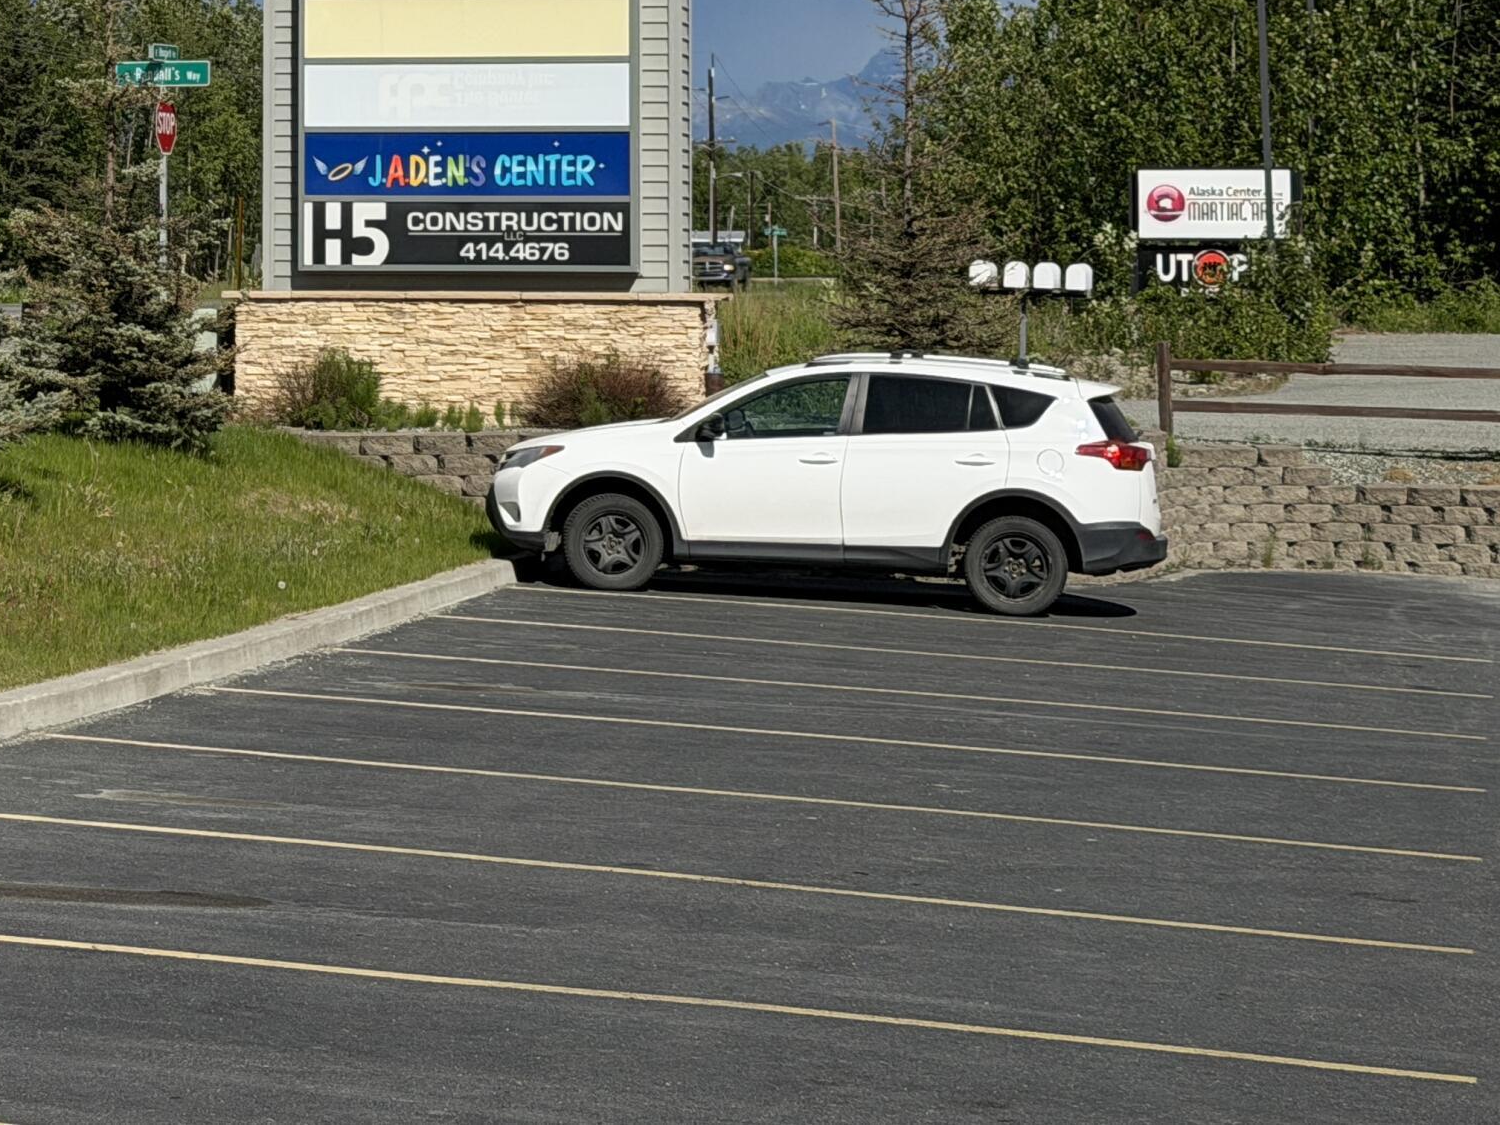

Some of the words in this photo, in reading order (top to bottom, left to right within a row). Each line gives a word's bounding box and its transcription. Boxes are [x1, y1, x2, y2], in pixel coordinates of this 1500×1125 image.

[186, 70, 201, 83] Way
[157, 112, 175, 135] STOP
[493, 153, 596, 187] CENTER
[1188, 186, 1223, 197] Alaska
[1226, 186, 1262, 197] Center
[1188, 201, 1247, 221] MARTIAL
[406, 211, 623, 232] CONSTRUCTION
[304, 202, 390, 265] H5
[504, 232, 524, 242] LLC
[459, 242, 569, 261] 414.4676
